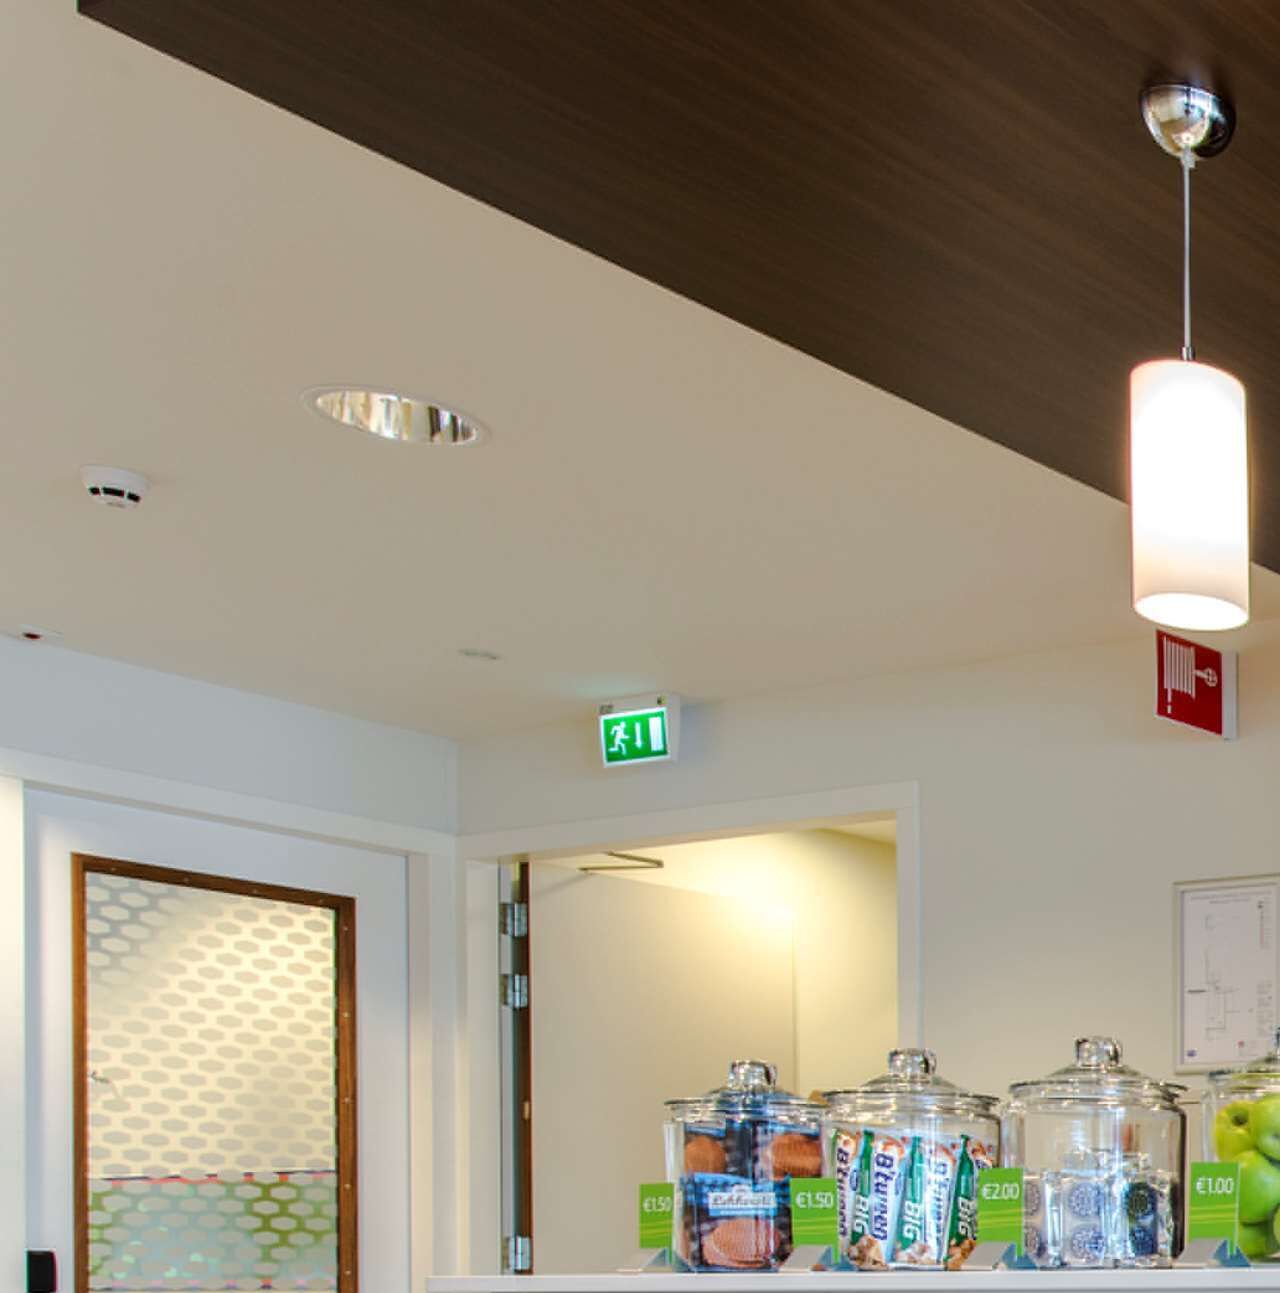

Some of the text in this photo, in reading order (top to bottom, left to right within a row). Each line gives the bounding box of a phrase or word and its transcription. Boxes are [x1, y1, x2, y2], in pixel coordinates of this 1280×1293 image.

[982, 1182, 1020, 1201] €2.00
[1195, 1177, 1234, 1195] €1.00
[642, 1195, 672, 1214] €1.50
[795, 1190, 835, 1210] €1.50
[853, 1194, 870, 1235] BIG
[902, 1199, 922, 1243] BIG
